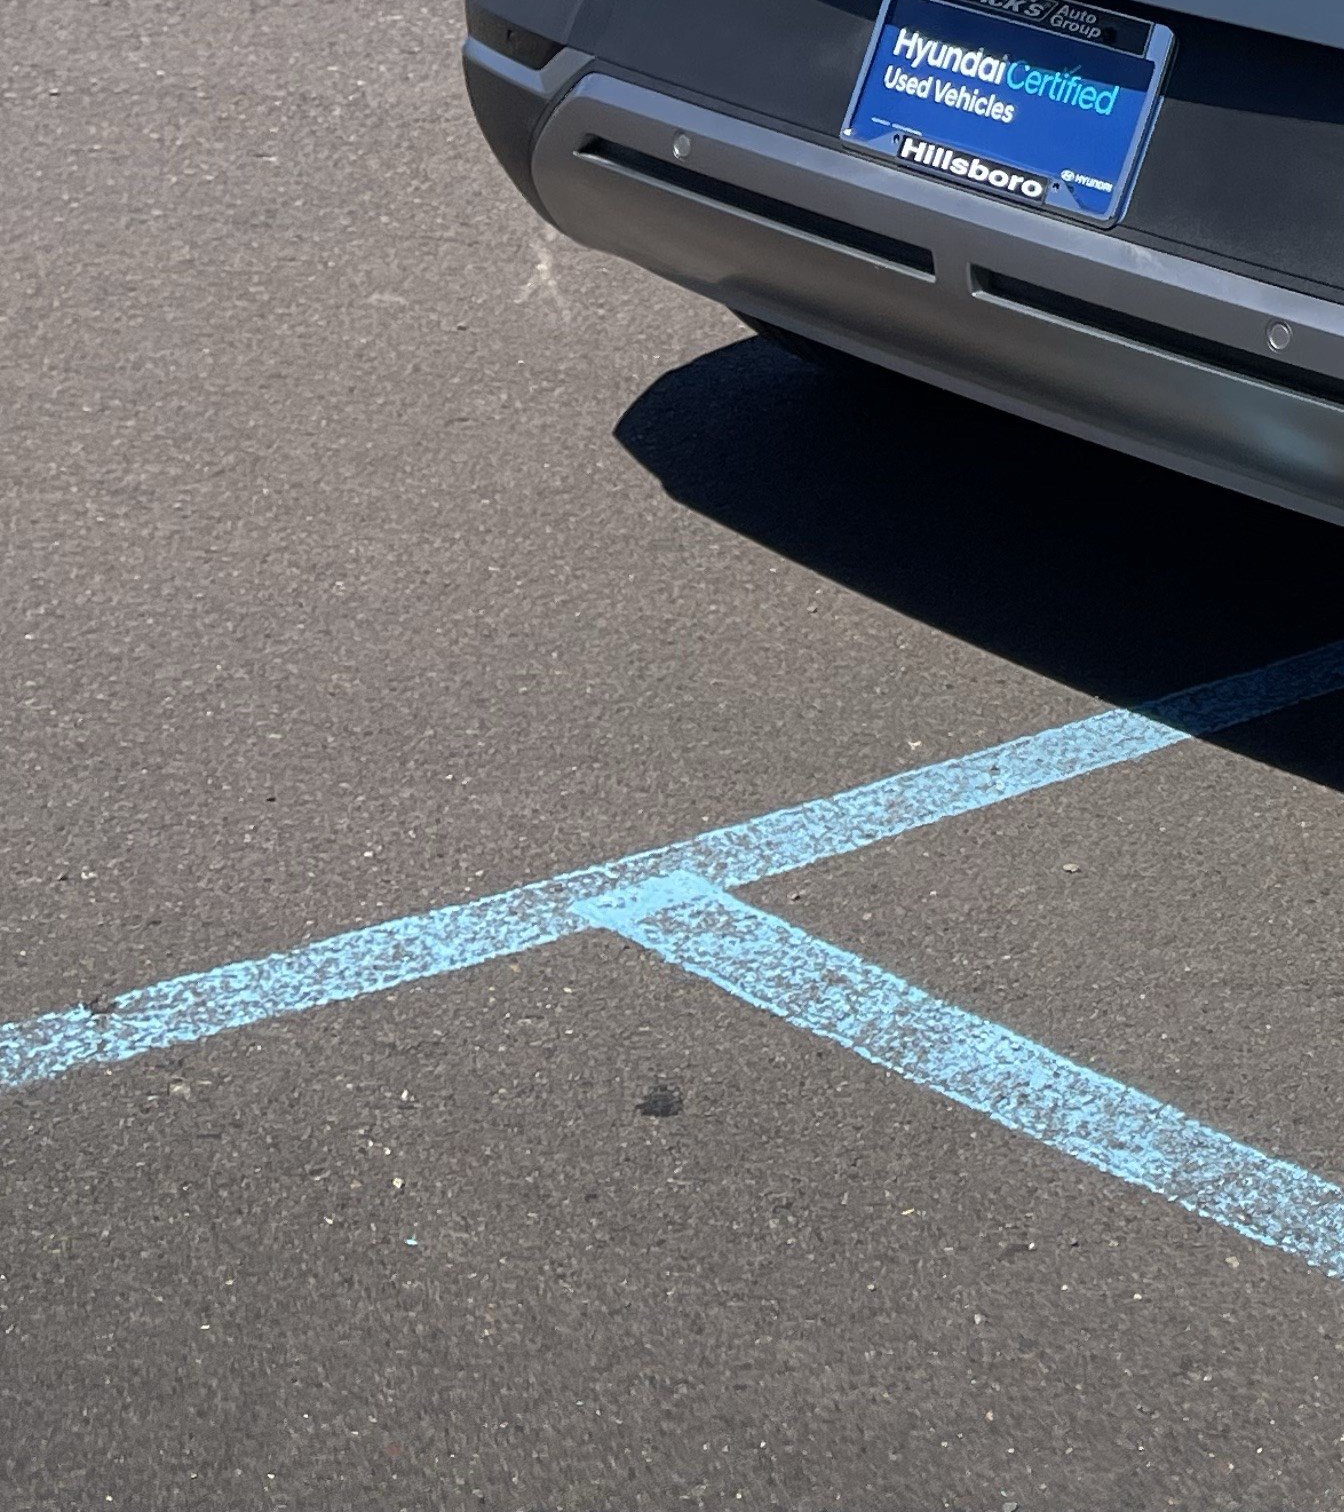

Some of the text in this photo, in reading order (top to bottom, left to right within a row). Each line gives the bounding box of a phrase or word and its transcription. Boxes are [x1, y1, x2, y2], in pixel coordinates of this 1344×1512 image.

[1050, 14, 1102, 39] Group
[1056, 4, 1098, 25] Auto
[883, 65, 1016, 124] Used Vehicles
[901, 137, 1044, 198] Hillsboro
